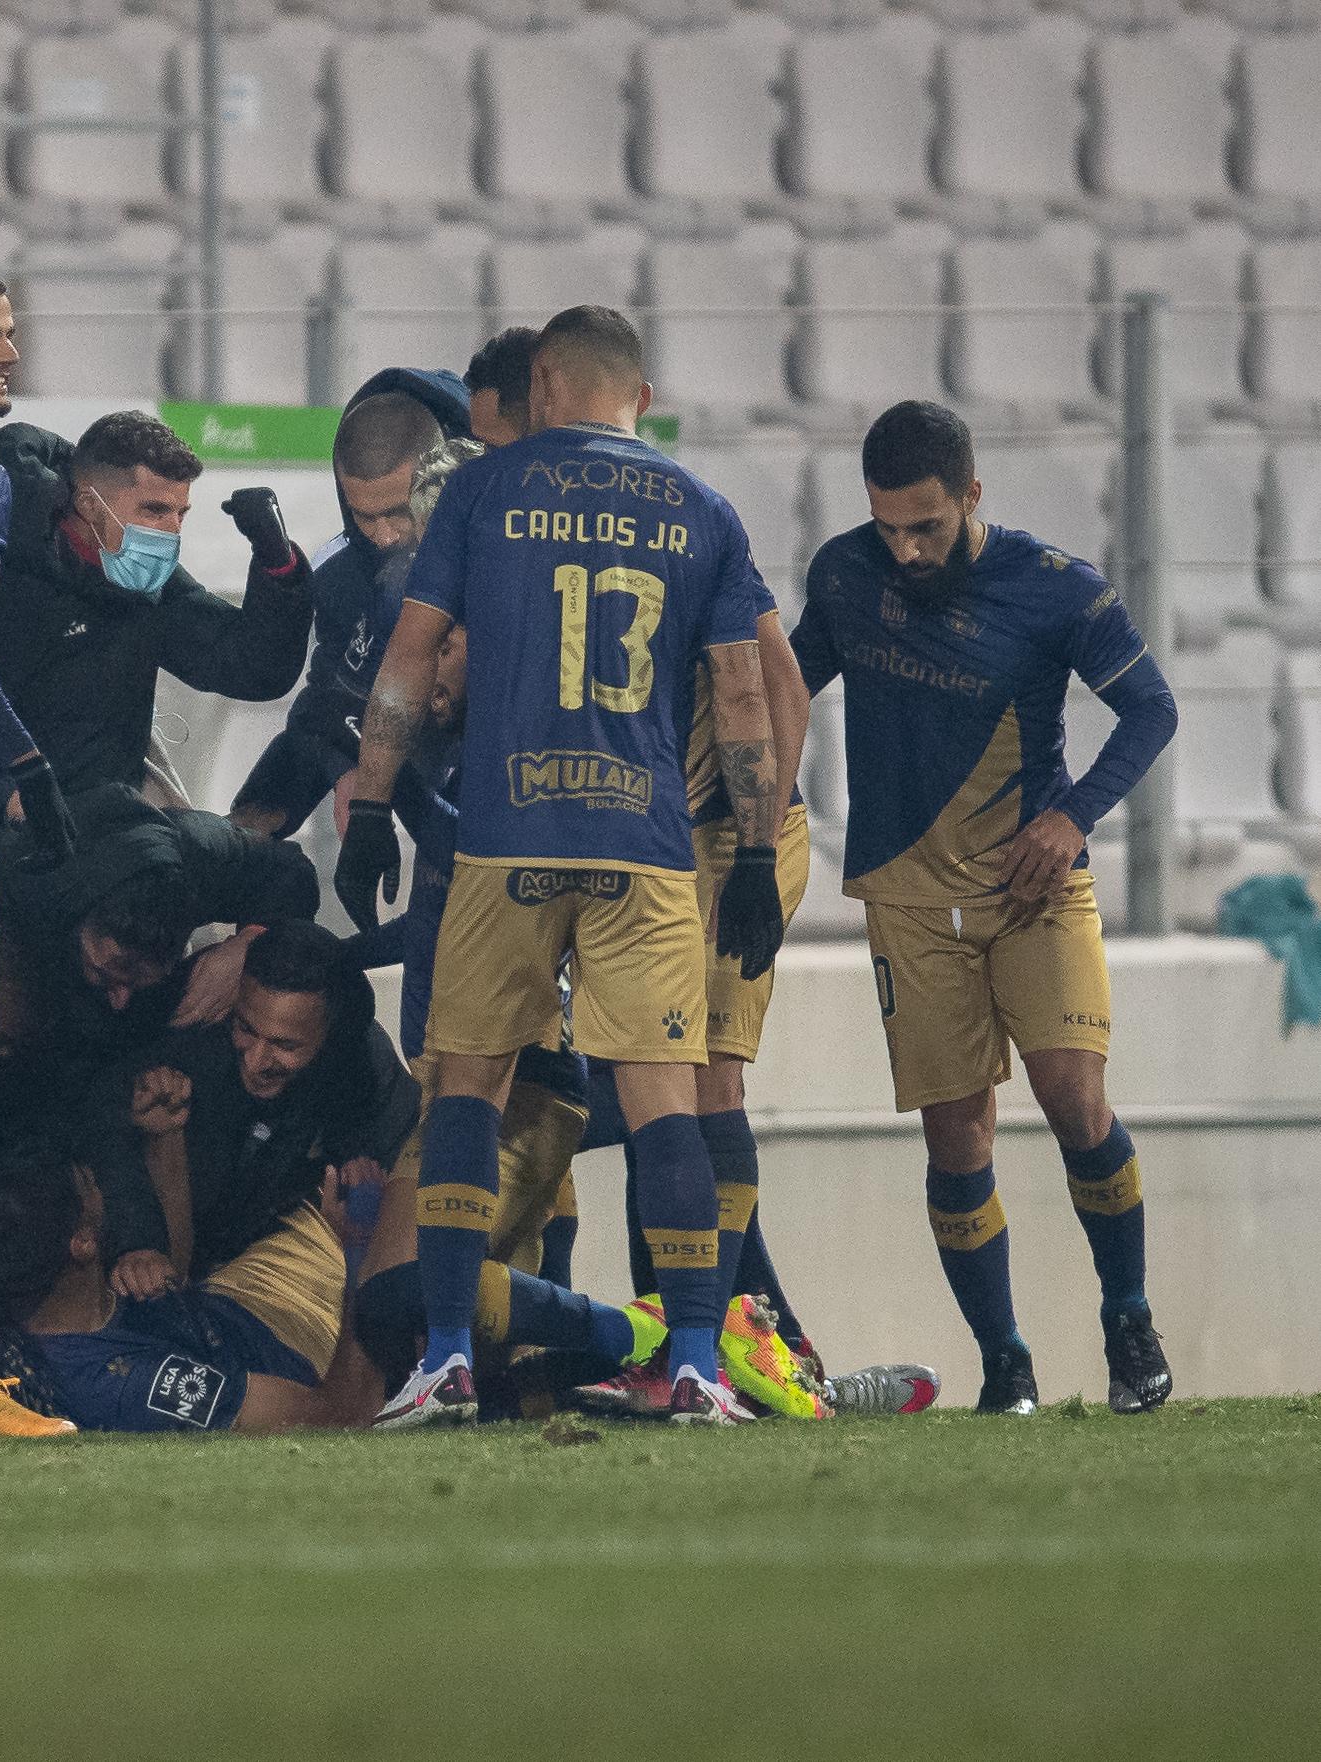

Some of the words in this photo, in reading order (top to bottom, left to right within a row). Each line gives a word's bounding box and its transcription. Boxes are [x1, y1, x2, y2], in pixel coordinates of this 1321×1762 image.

[521, 460, 685, 507] AÇORES
[504, 509, 636, 547] CARLOS
[647, 522, 694, 558] JR.
[554, 564, 665, 713] 13
[520, 757, 649, 799] MULATA
[425, 1196, 494, 1219] CDSC
[159, 1367, 180, 1396] LIGA
[176, 1365, 207, 1417] NOS
